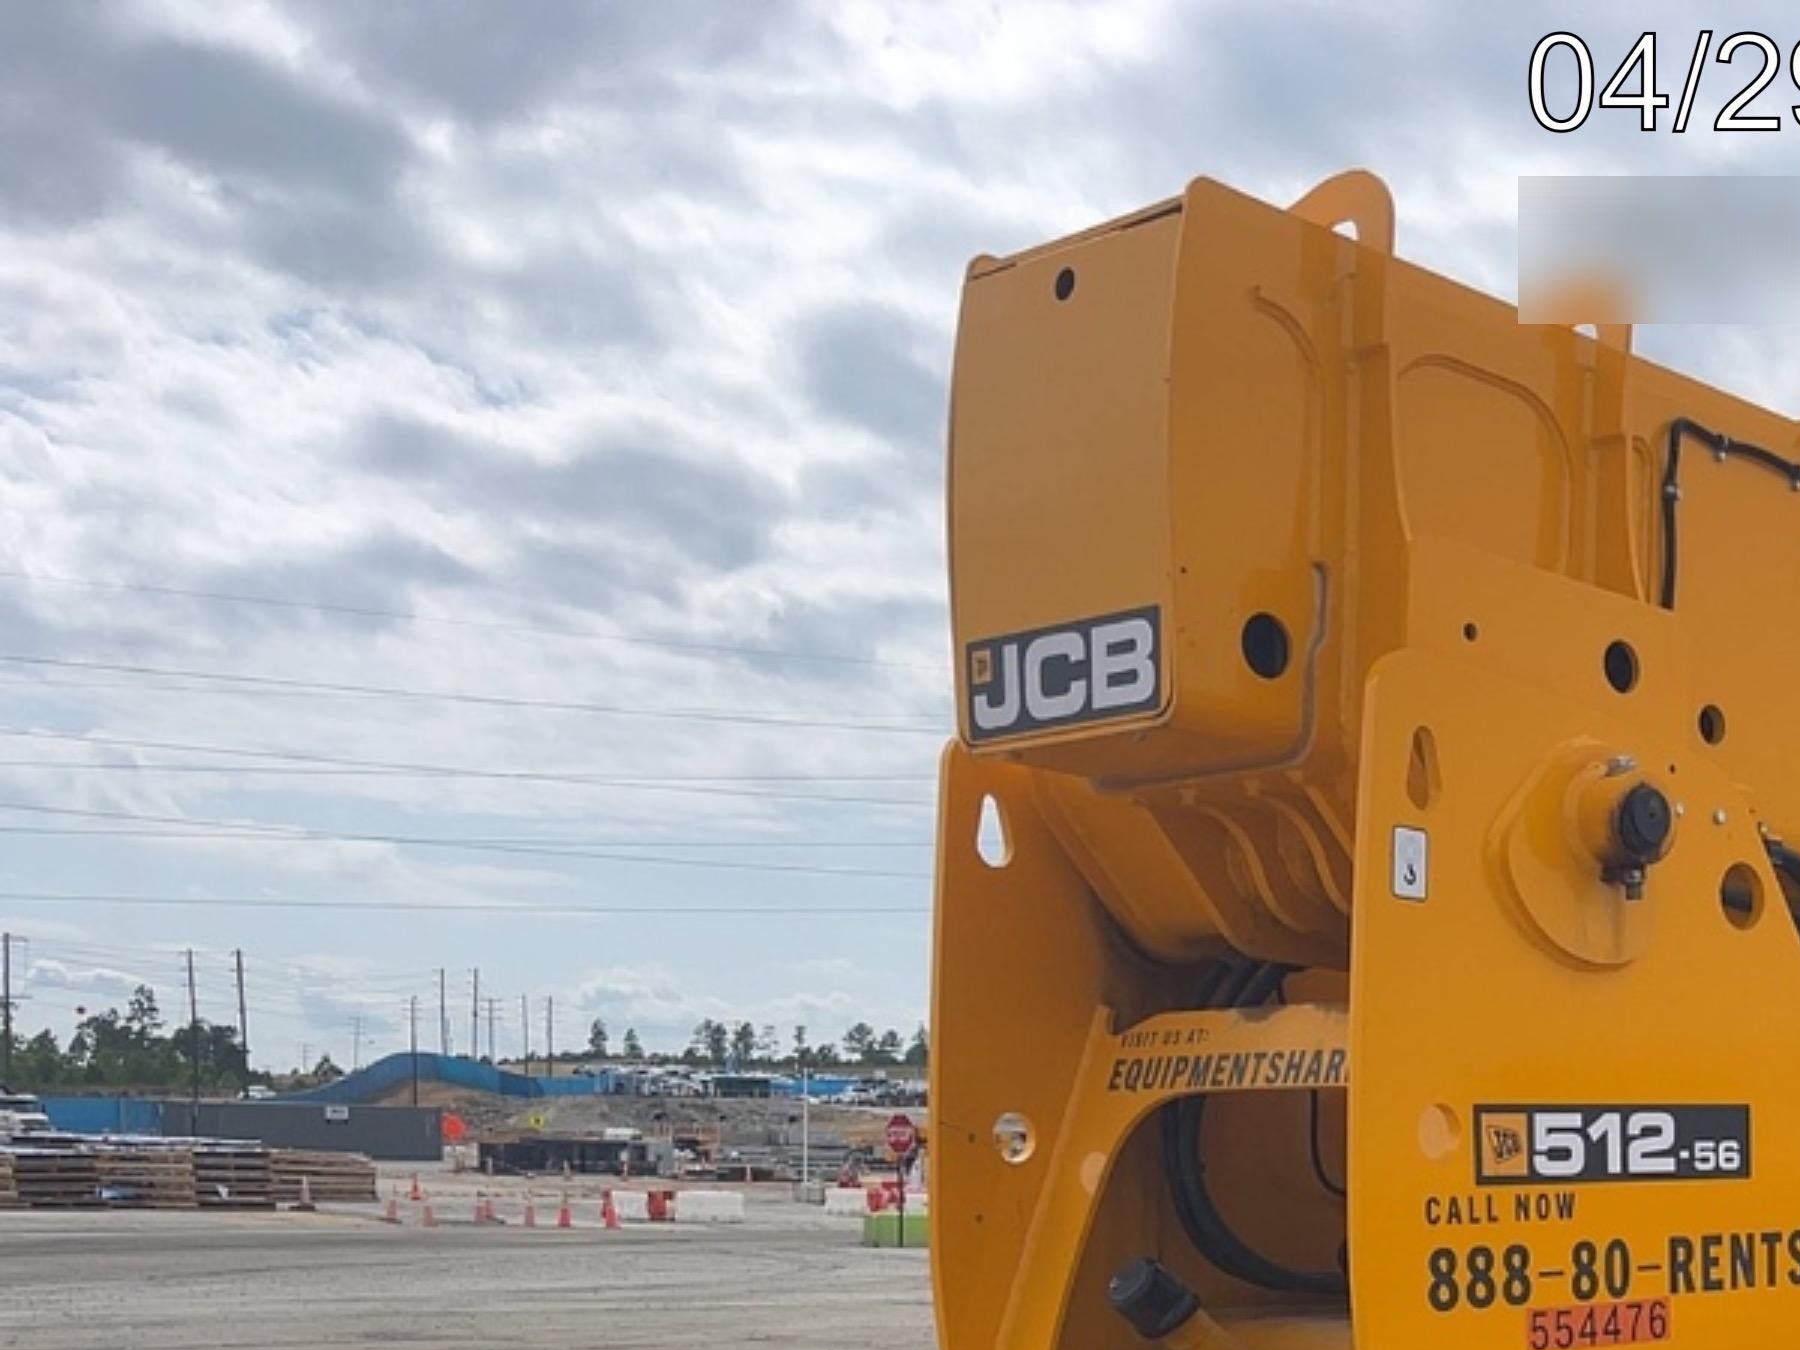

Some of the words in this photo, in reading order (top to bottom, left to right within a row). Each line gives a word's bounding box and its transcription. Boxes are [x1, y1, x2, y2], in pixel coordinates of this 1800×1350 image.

[974, 618, 1156, 731] JCB
[1108, 1049, 1349, 1092] EQUIPMENTSHAR
[1426, 1194, 1499, 1225] CALL
[1514, 1192, 1576, 1222] NOW
